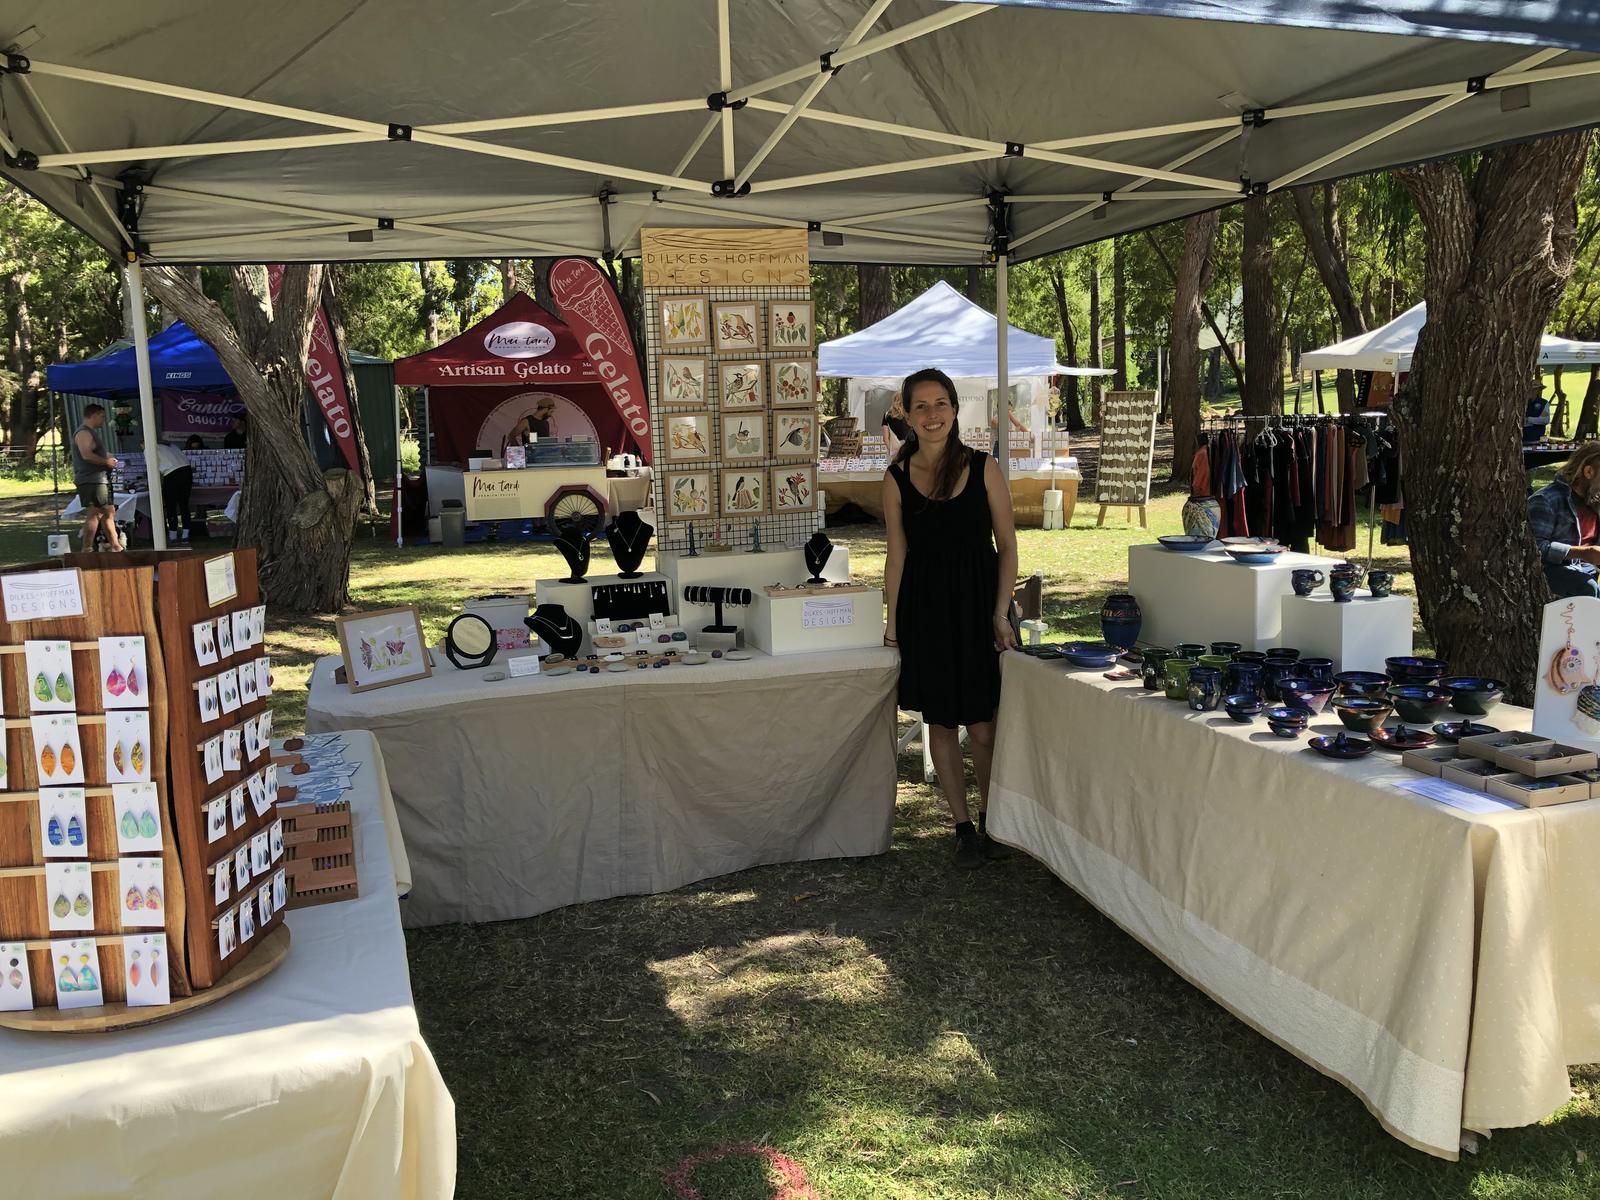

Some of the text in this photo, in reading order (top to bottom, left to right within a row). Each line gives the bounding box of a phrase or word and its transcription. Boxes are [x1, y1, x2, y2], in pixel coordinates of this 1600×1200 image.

[647, 253, 805, 264] DILKES-HOFFMAN
[648, 269, 805, 284] DESIGNS
[165, 371, 192, 380] KINGS
[439, 364, 506, 377] Artisan
[513, 361, 571, 379] Gelato
[585, 332, 649, 437] Gelato
[10, 598, 78, 614] DESIGNS
[804, 615, 853, 627] DESIGNS
